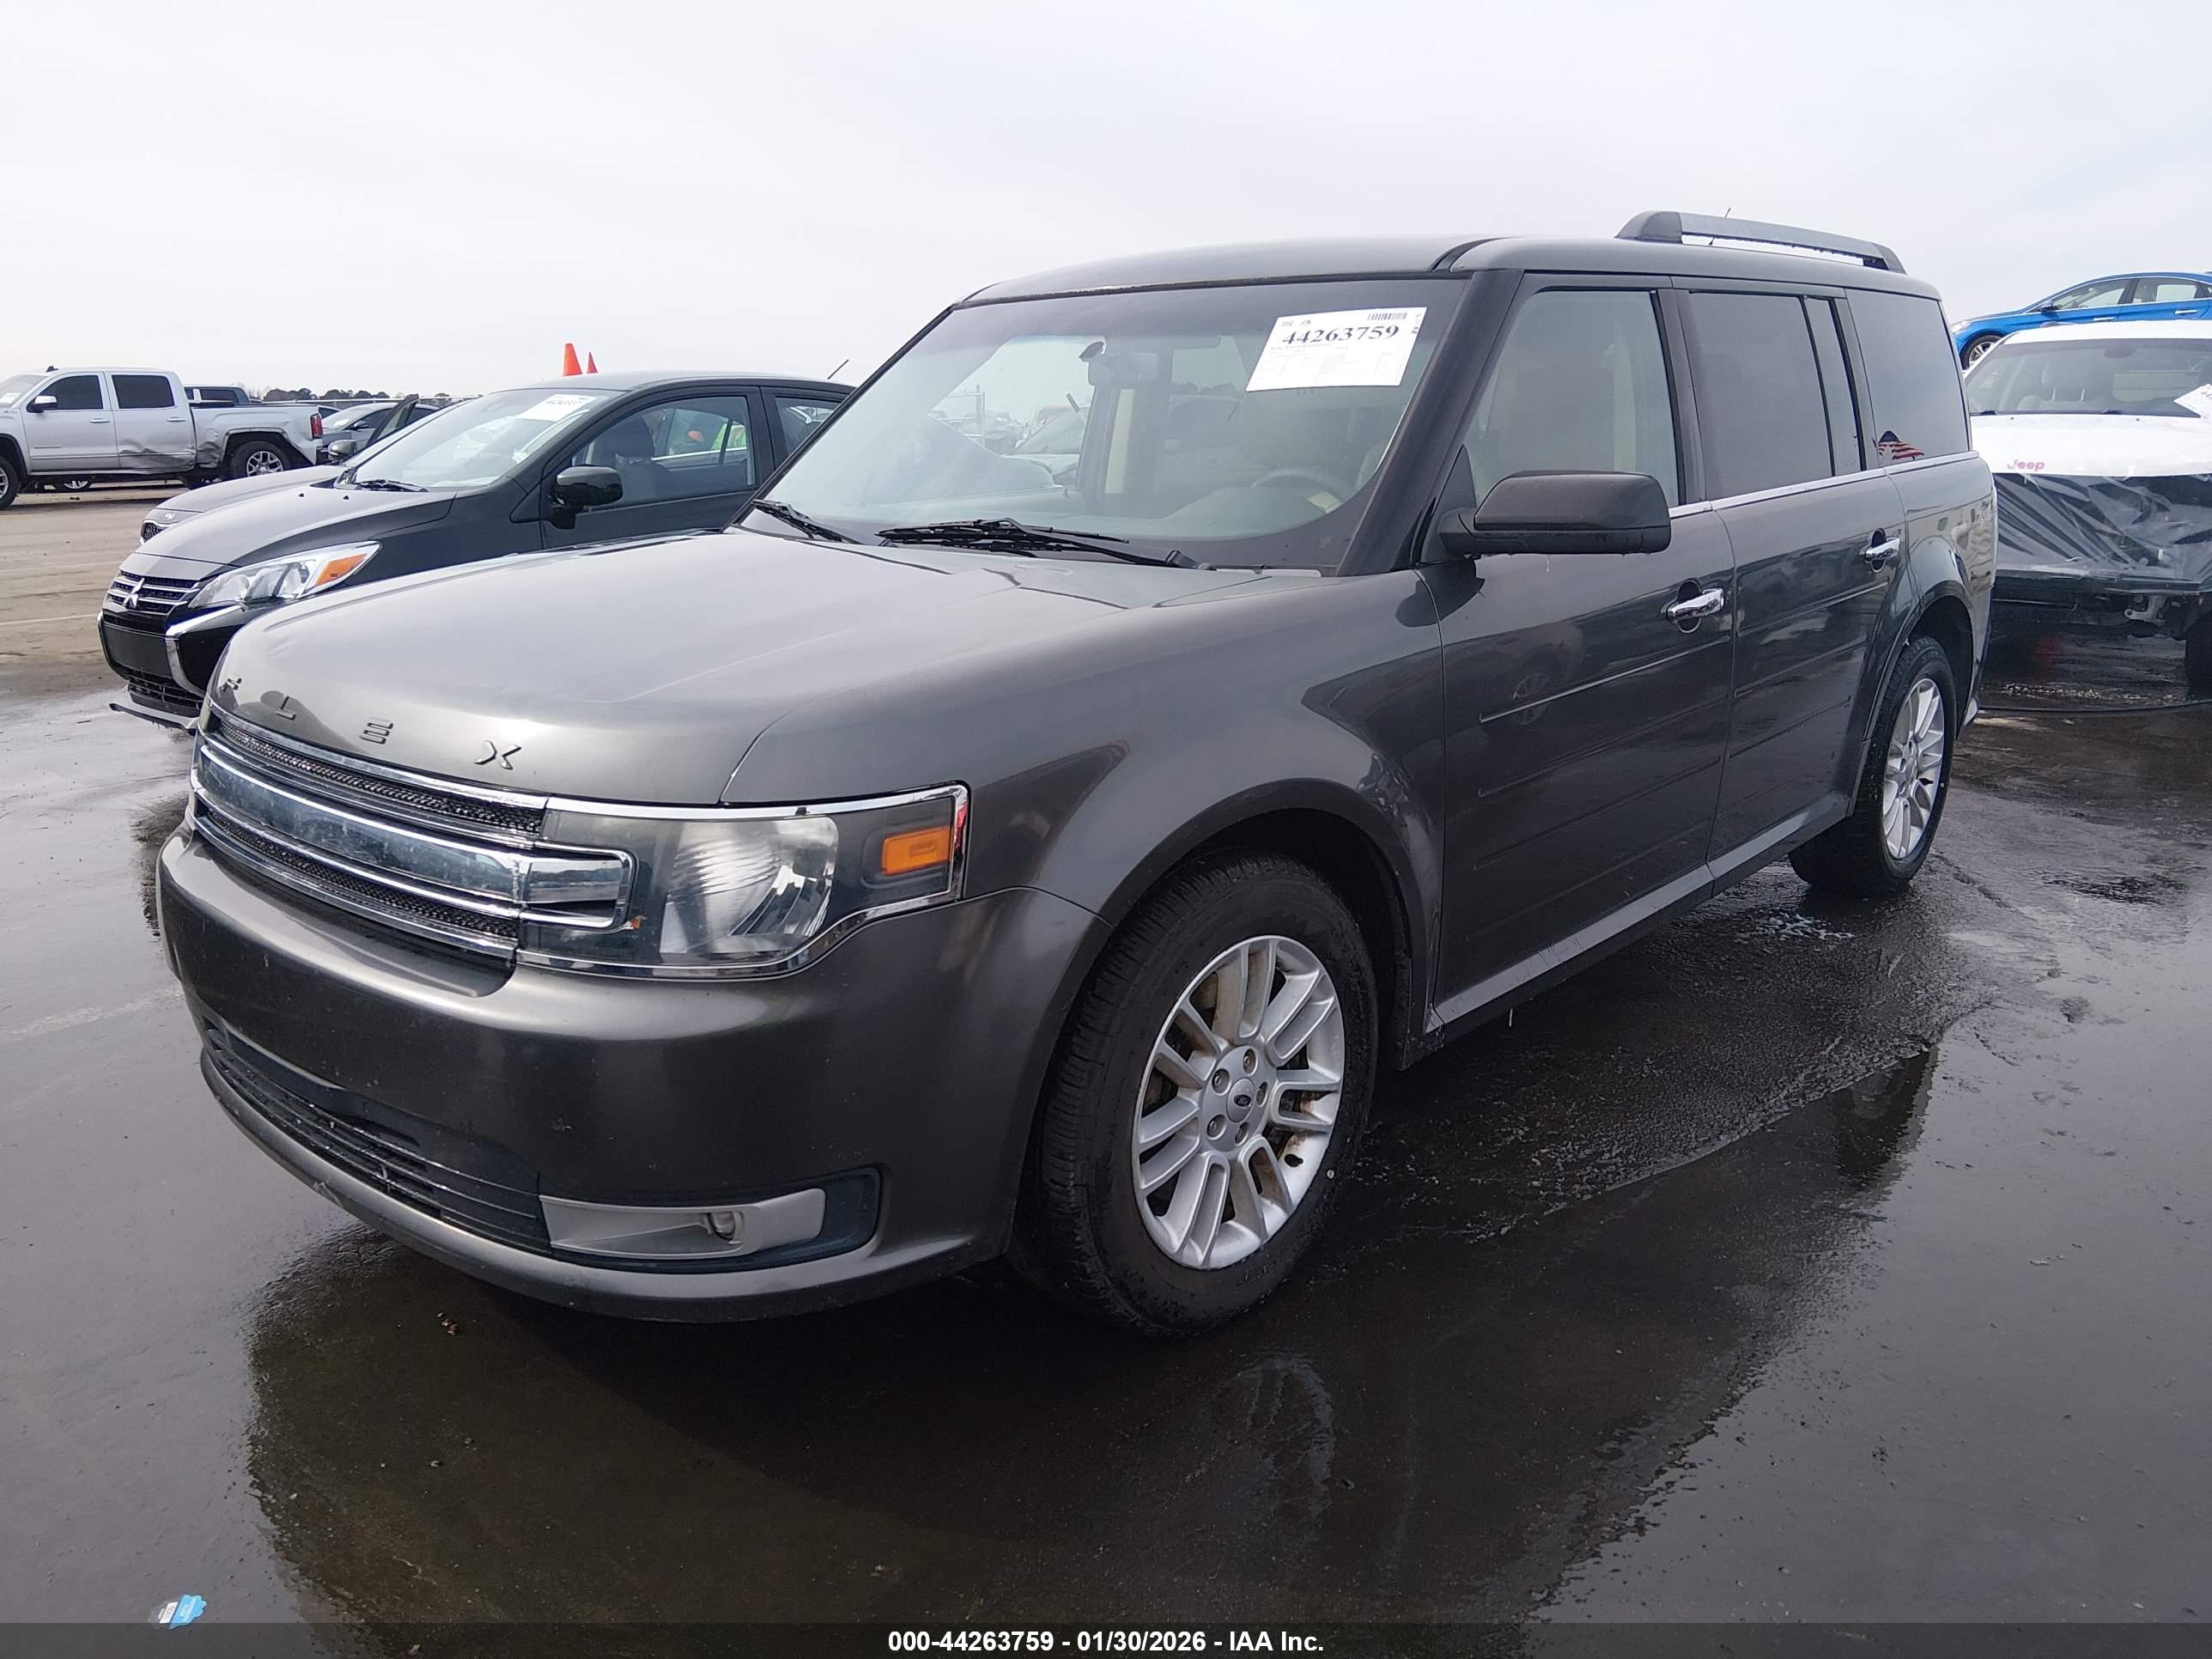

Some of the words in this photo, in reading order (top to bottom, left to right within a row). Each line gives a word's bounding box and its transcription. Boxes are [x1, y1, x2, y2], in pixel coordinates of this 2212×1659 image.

[1281, 325, 1400, 344] 44263759
[2007, 459, 2045, 471] Jeep
[222, 674, 522, 770] FLEX
